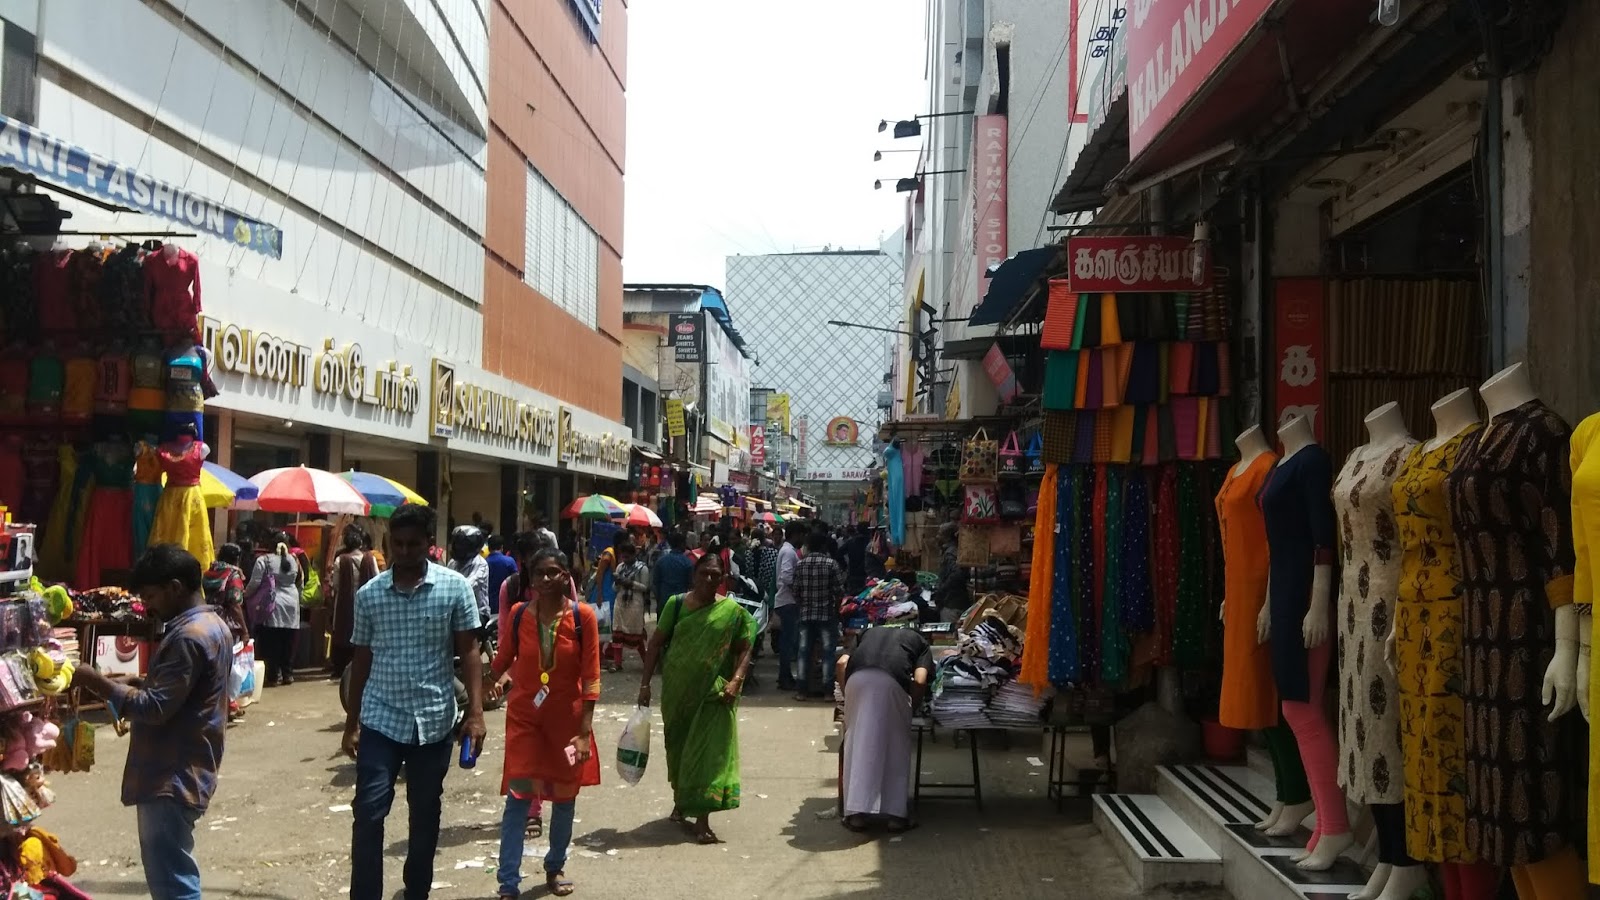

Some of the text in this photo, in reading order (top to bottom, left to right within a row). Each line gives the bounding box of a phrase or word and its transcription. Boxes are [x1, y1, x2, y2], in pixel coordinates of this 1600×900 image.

[1132, 0, 1240, 133] KALANJI
[87, 155, 226, 234] FASHION
[985, 127, 1003, 269] RATHNA STOR
[456, 381, 556, 447] SARAVANA STORES
[752, 426, 764, 437] A
[752, 444, 763, 455] Z
